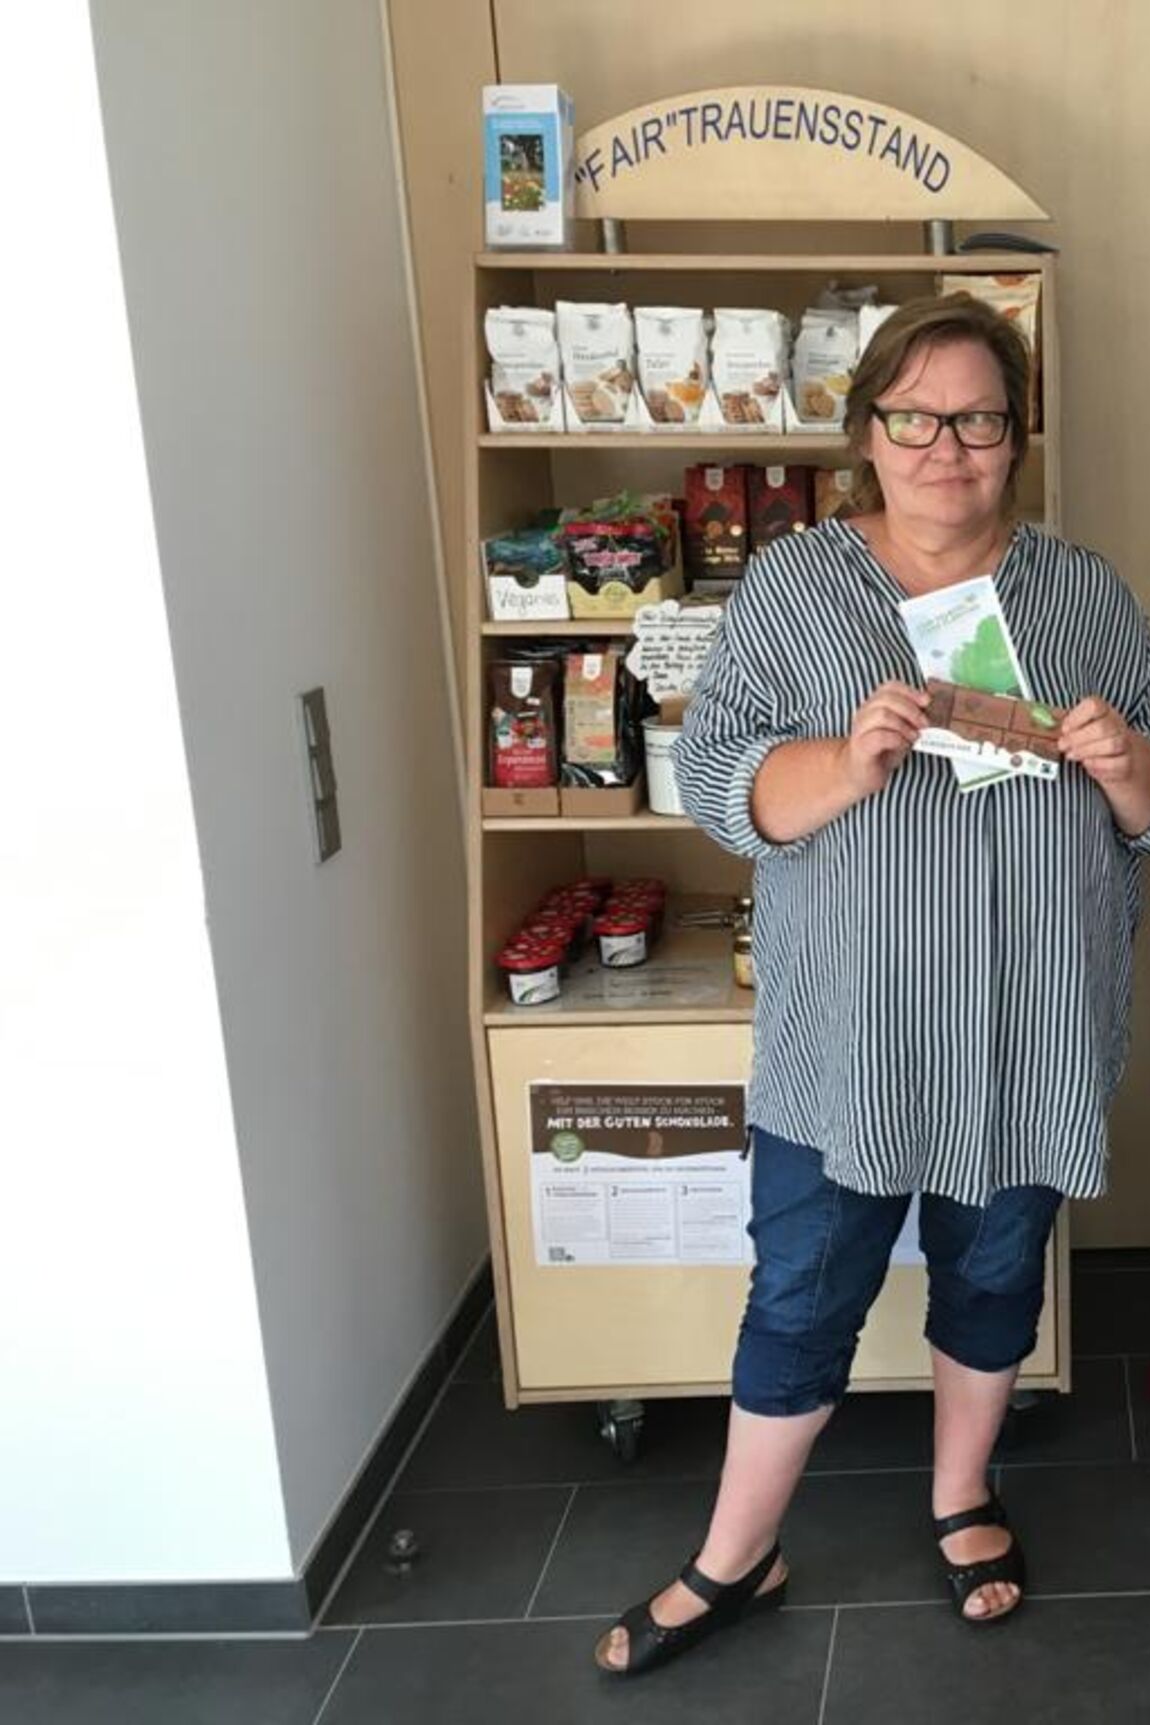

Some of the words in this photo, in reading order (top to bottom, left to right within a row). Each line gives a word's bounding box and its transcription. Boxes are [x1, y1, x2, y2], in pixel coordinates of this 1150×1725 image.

[547, 1117, 572, 1129] MIT
[576, 1117, 602, 1129] DER
[604, 1116, 652, 1129] GUTEN
